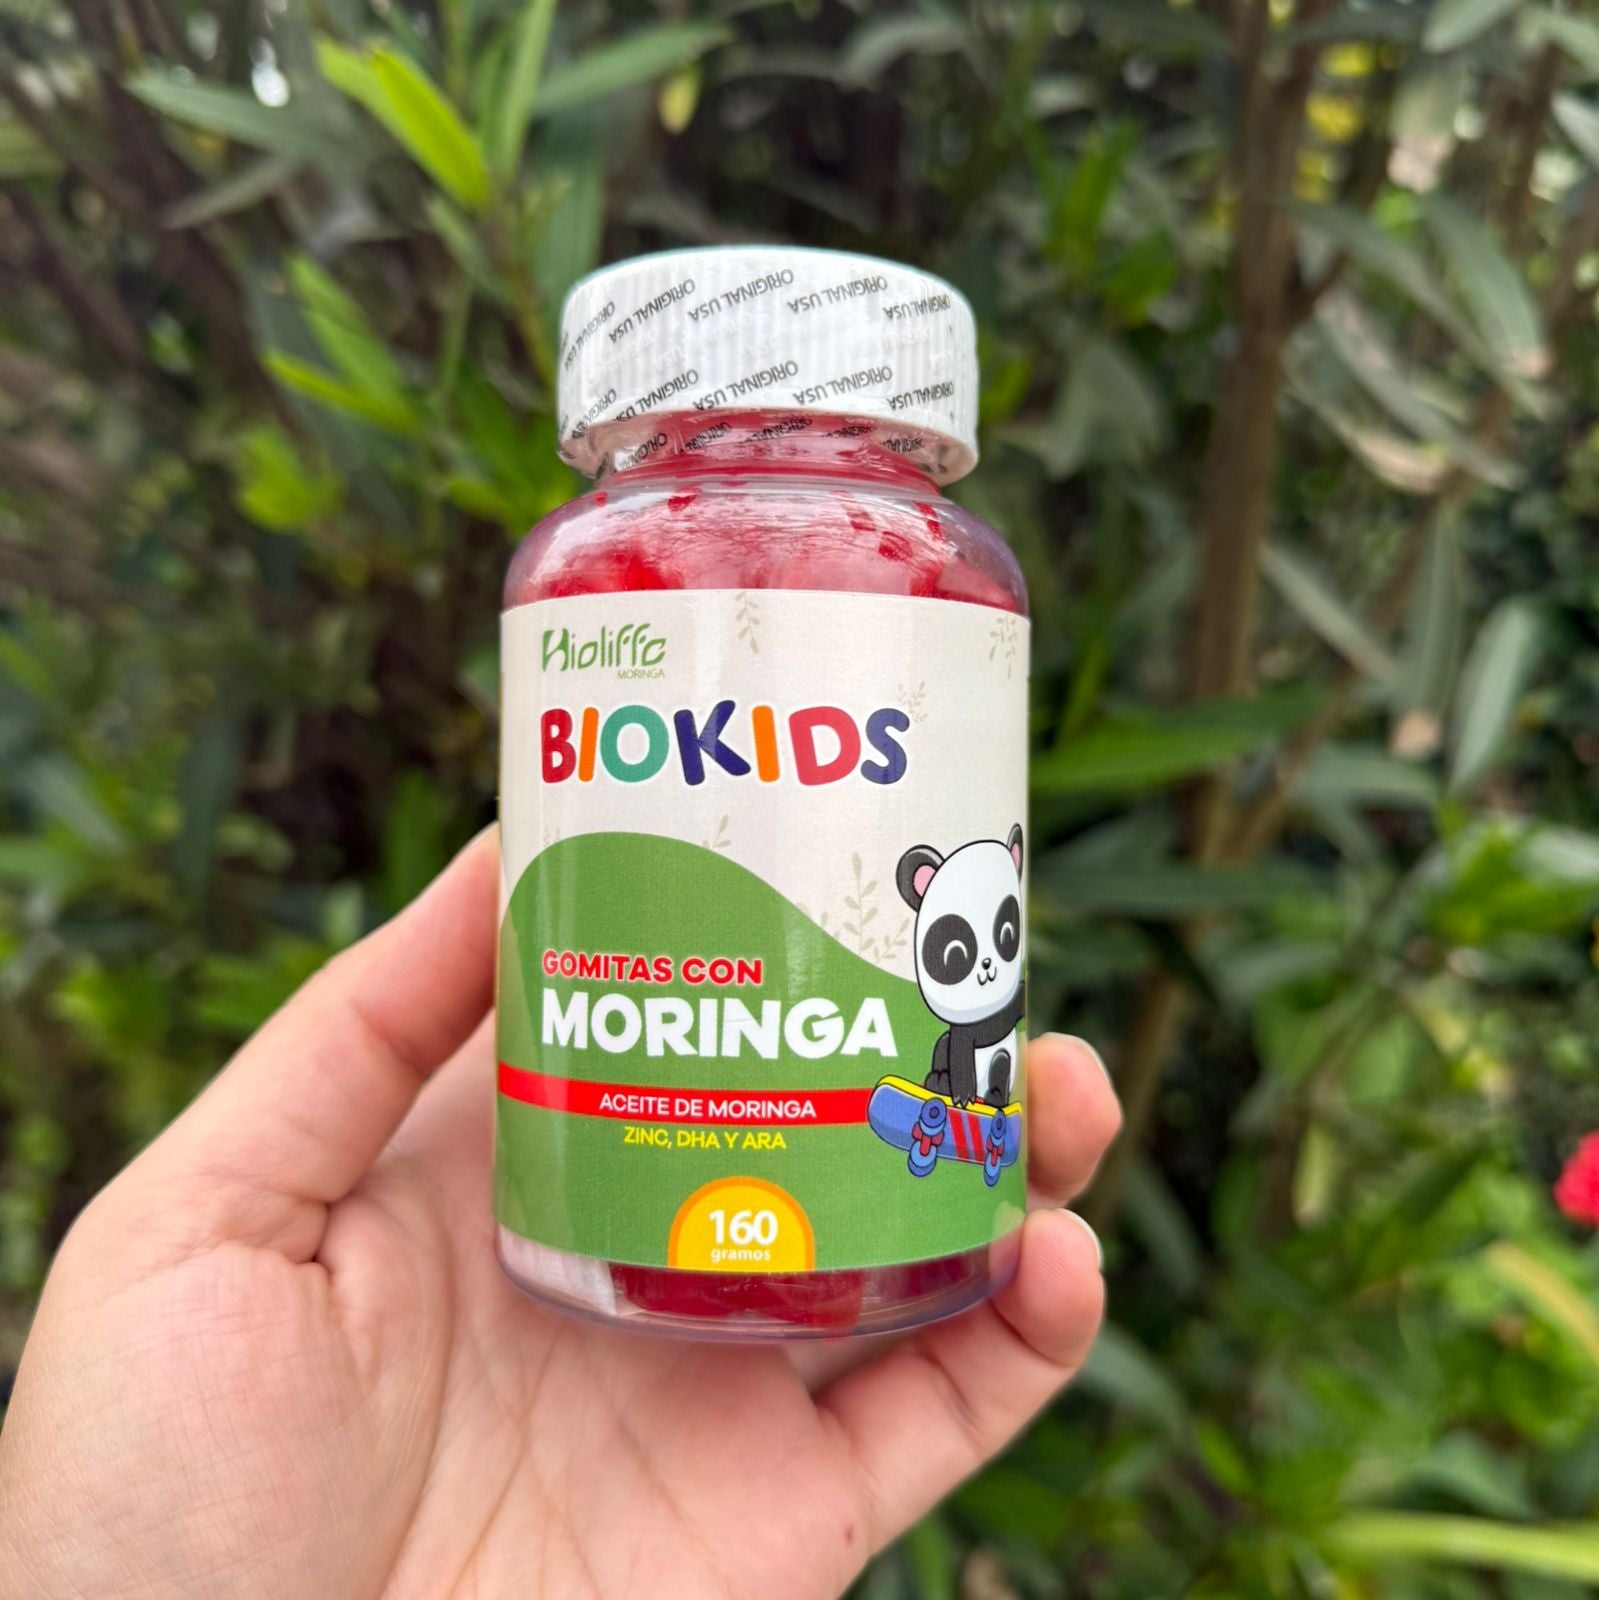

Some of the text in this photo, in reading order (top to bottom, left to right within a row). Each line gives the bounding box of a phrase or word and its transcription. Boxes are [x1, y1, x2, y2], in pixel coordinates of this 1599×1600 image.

[635, 279, 696, 325] ORIGINAL
[688, 269, 795, 323] ORIGINAL USA
[787, 275, 888, 313] ORIGINAL USA
[883, 294, 951, 320] ORIGINAL USA
[608, 315, 634, 344] USA
[640, 368, 700, 409] ORIGINAL
[693, 360, 799, 411] ORIGINAL USA
[793, 366, 893, 406] ORIGINAL USA
[886, 381, 954, 411] ORIGINAL USA
[617, 669, 666, 680] MORINGA
[540, 700, 911, 786] BIOKIDS
[542, 949, 764, 986] GOMITAS CON
[541, 988, 899, 1060] MORINGA
[599, 1093, 817, 1119] ACEITE DE MORINGA
[623, 1126, 787, 1150] ZINC, DHA Y ARA
[708, 1209, 779, 1246] 160
[710, 1247, 772, 1263] gramos
